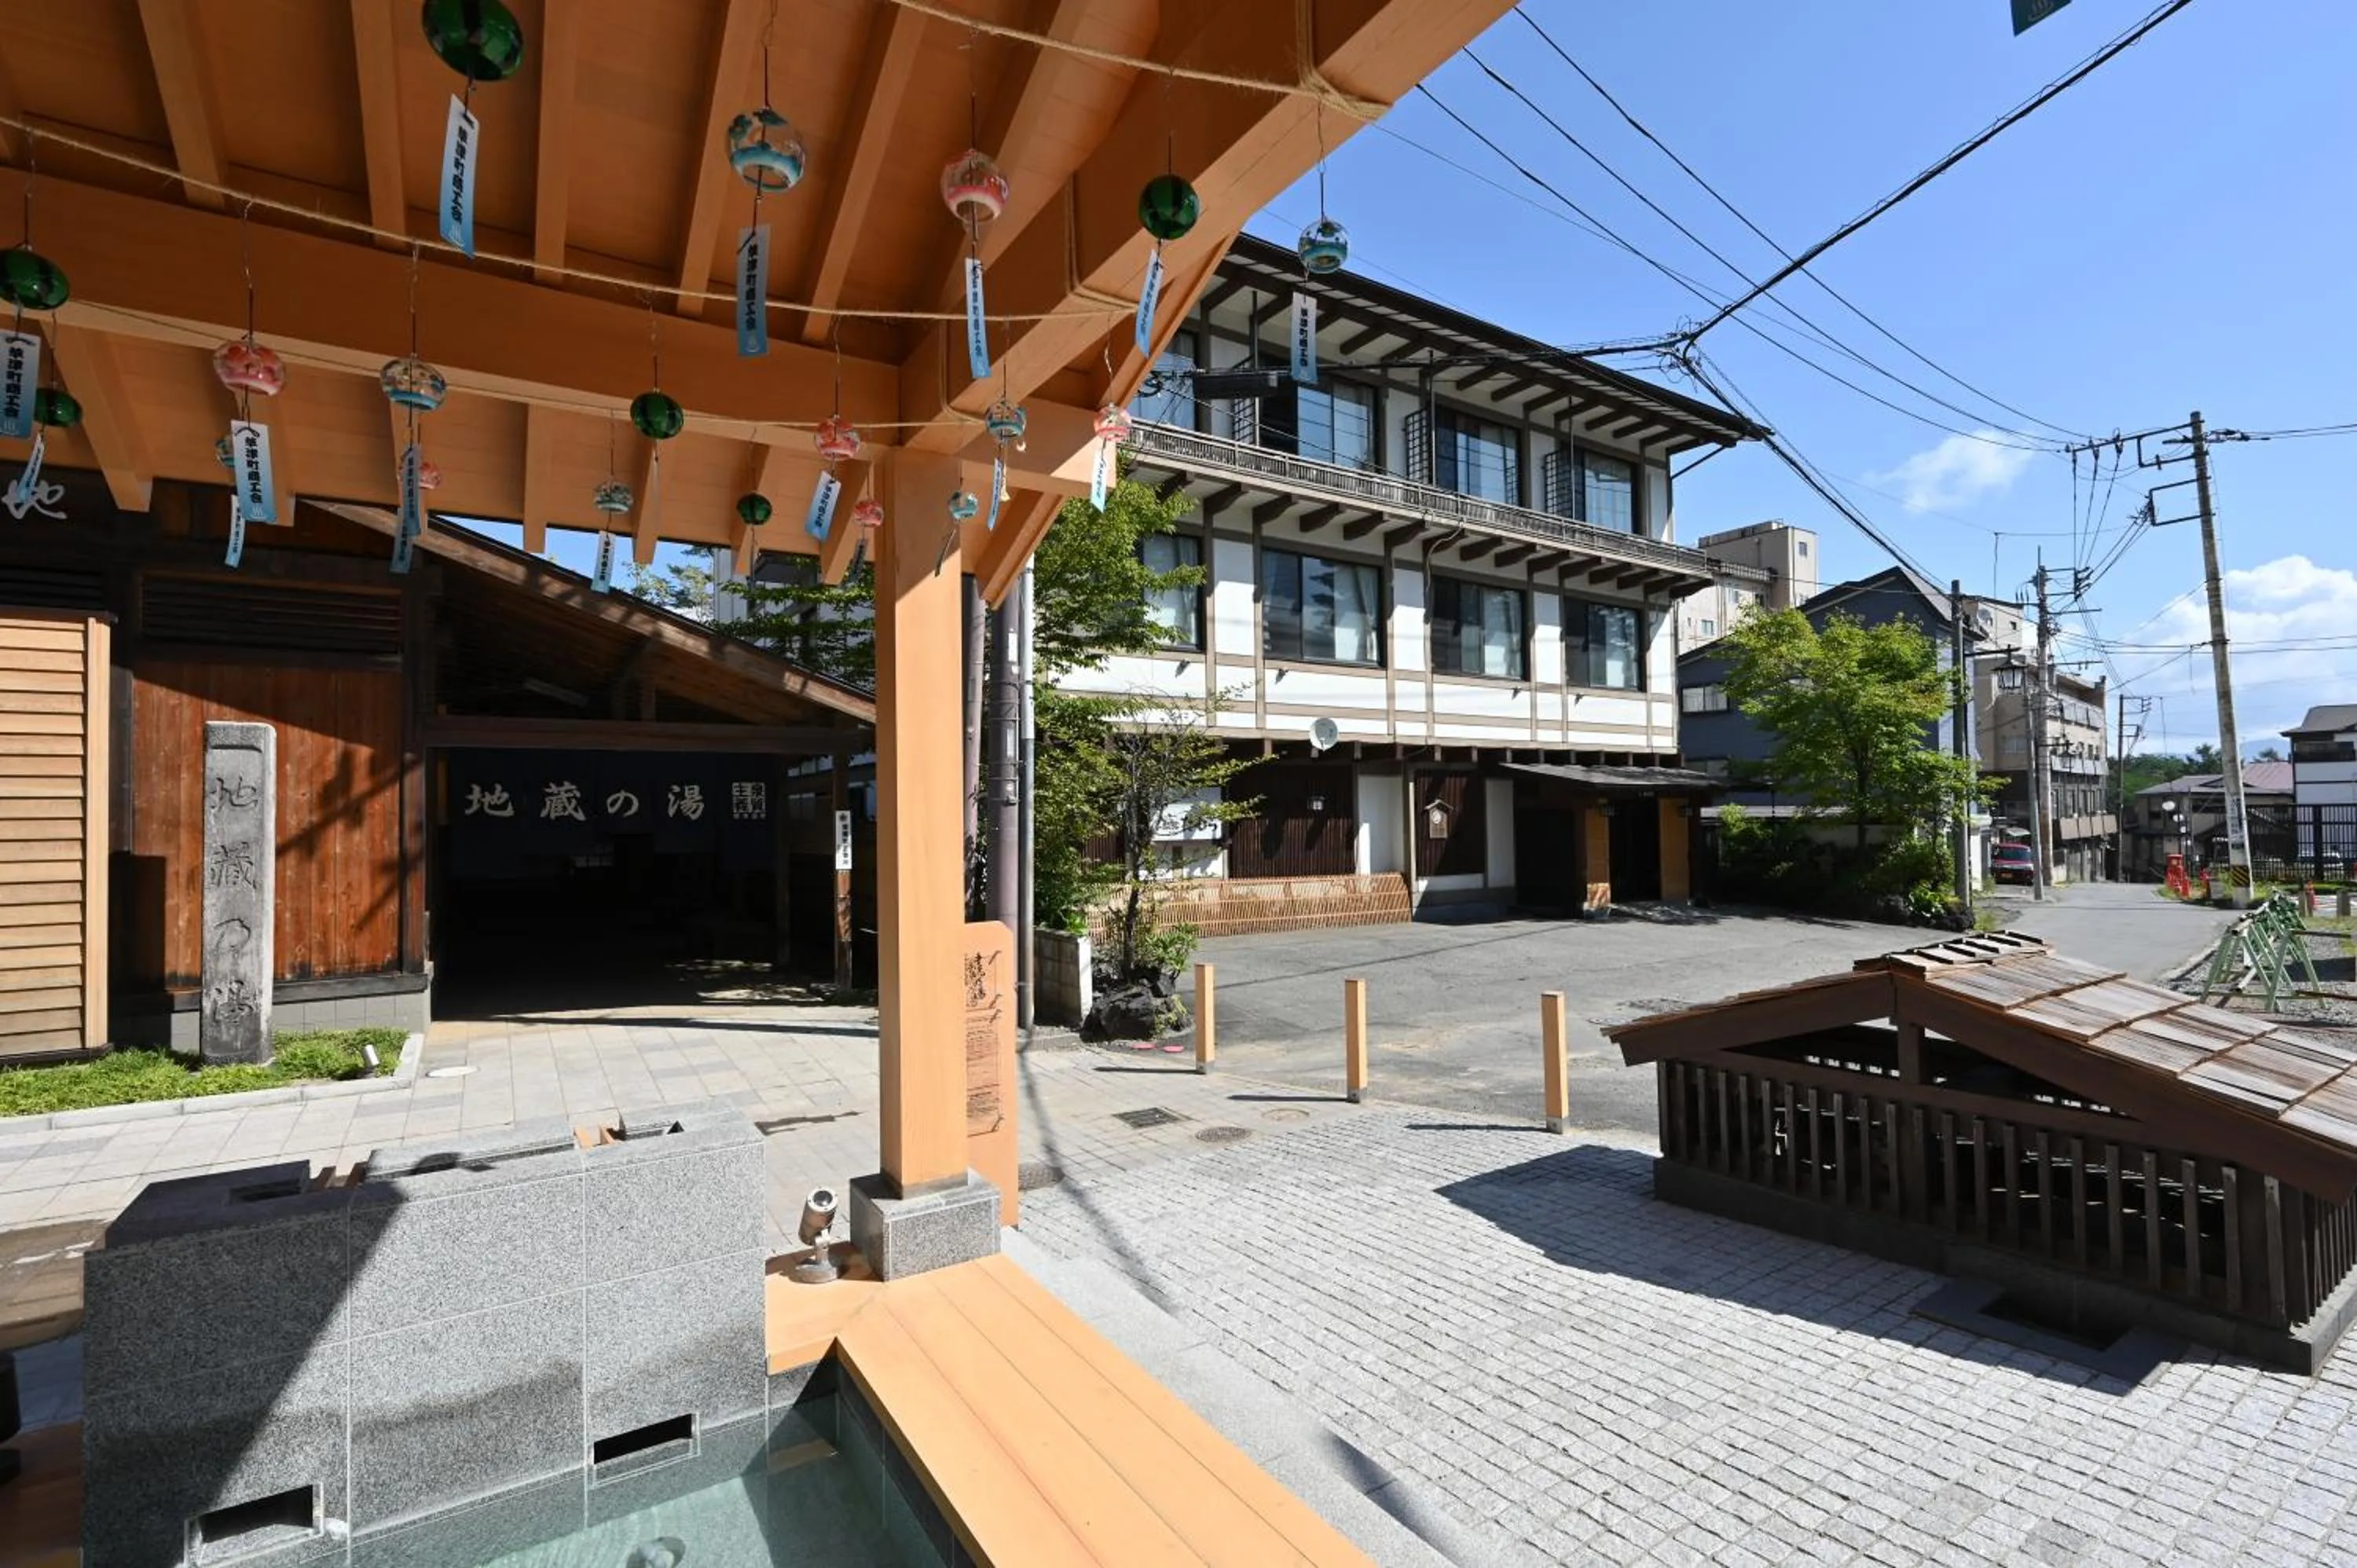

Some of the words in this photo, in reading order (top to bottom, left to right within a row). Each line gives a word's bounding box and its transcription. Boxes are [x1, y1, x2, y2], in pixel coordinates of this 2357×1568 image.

[244, 436, 263, 504] 草津町商工会
[464, 781, 706, 822] 地蔵の湯
